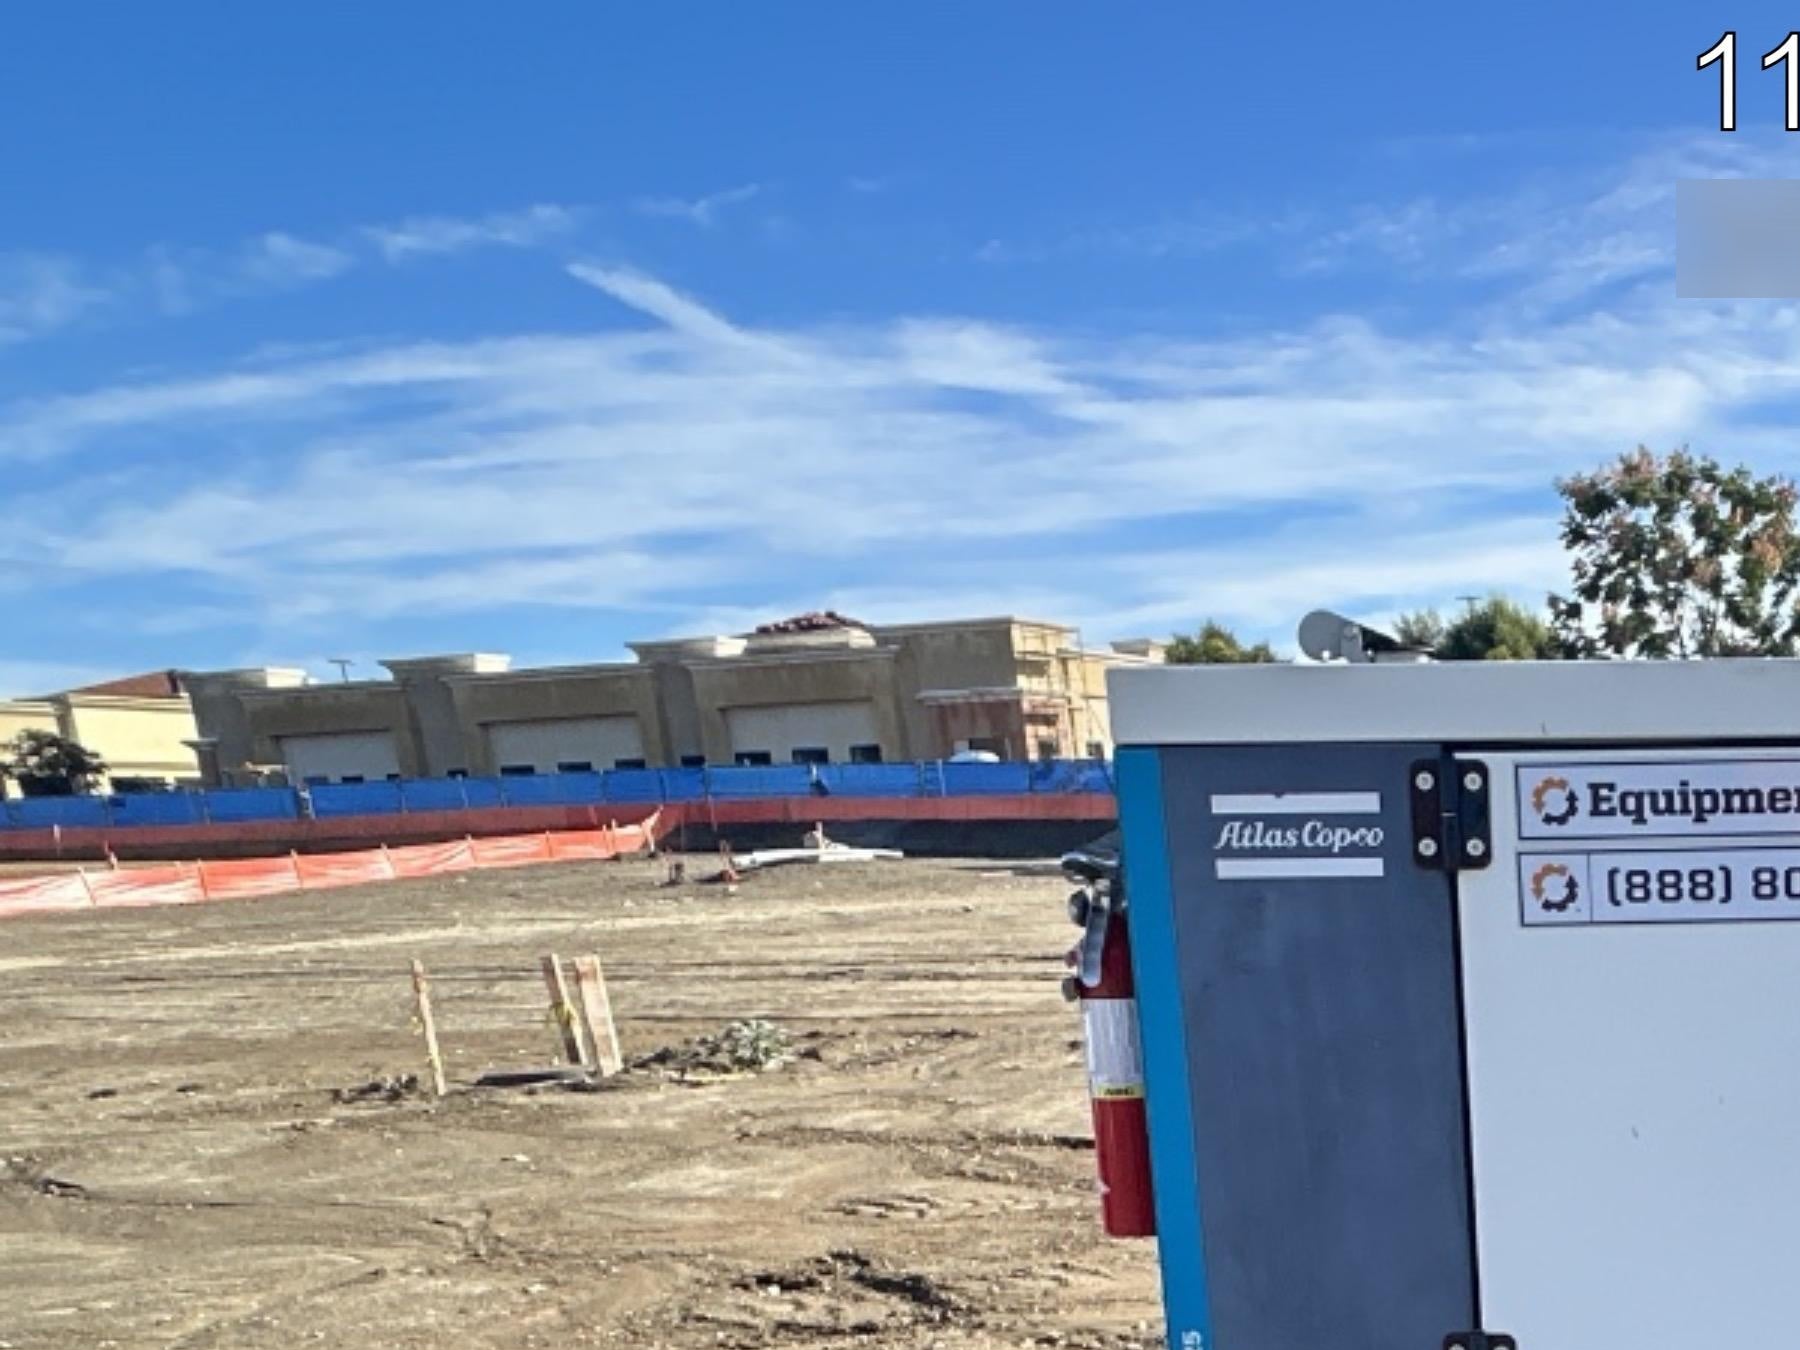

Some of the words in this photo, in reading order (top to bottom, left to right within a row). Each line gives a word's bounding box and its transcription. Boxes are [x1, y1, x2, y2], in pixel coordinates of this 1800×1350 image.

[1213, 821, 1300, 850] Atlas
[1301, 819, 1386, 853] Copco
[1607, 866, 1733, 908] (888)
